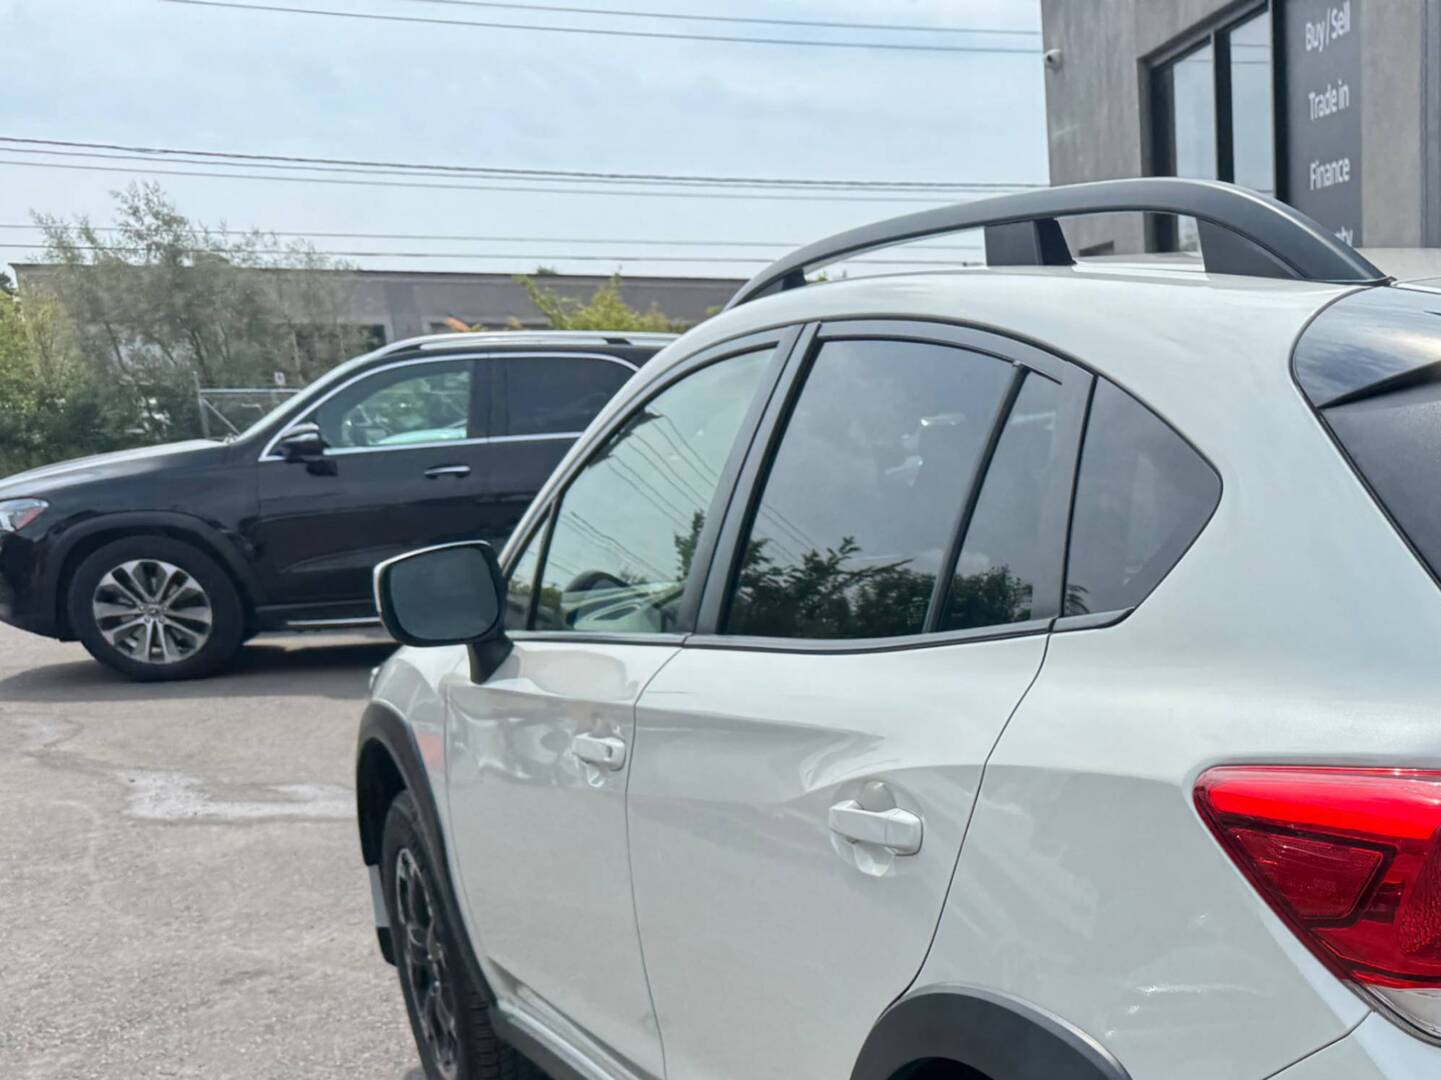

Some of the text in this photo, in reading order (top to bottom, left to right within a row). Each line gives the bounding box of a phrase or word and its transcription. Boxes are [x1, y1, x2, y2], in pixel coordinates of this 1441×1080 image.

[1308, 78, 1350, 120] Trade in
[1310, 158, 1351, 190] Finance
